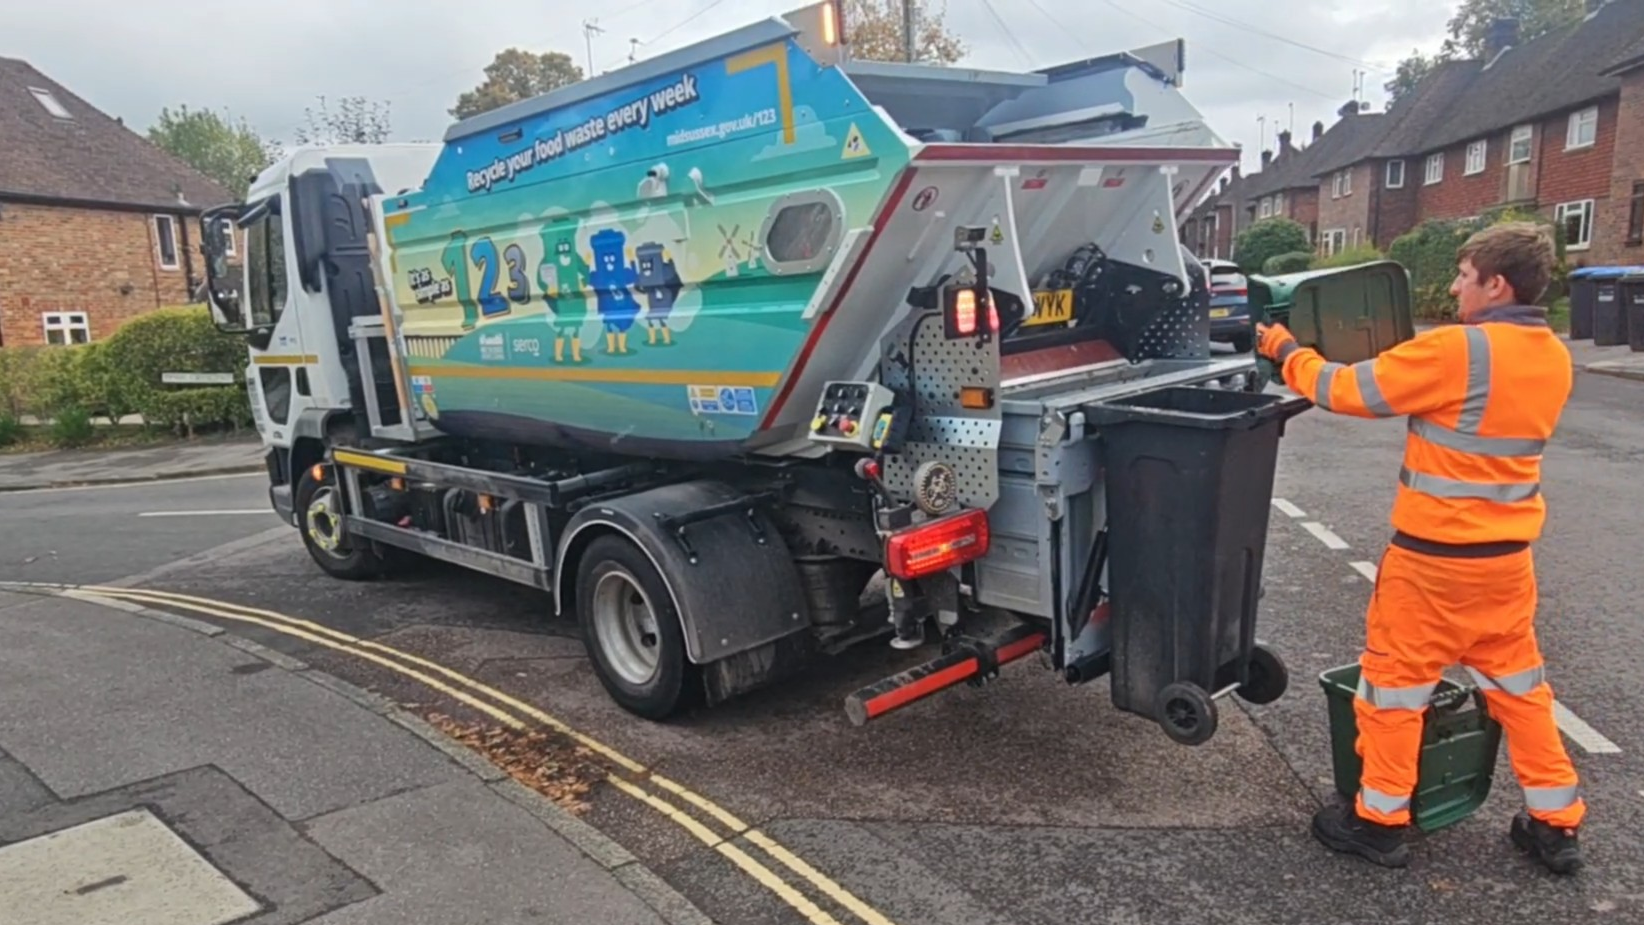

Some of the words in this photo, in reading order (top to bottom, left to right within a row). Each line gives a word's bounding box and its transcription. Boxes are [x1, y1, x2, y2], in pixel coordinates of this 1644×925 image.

[466, 158, 506, 191] Recycle
[505, 150, 534, 179] your
[533, 131, 563, 163] food
[563, 117, 606, 148] waste
[607, 97, 649, 129] every
[650, 73, 698, 113] week
[666, 107, 777, 147] midsussex.gov.uk/123
